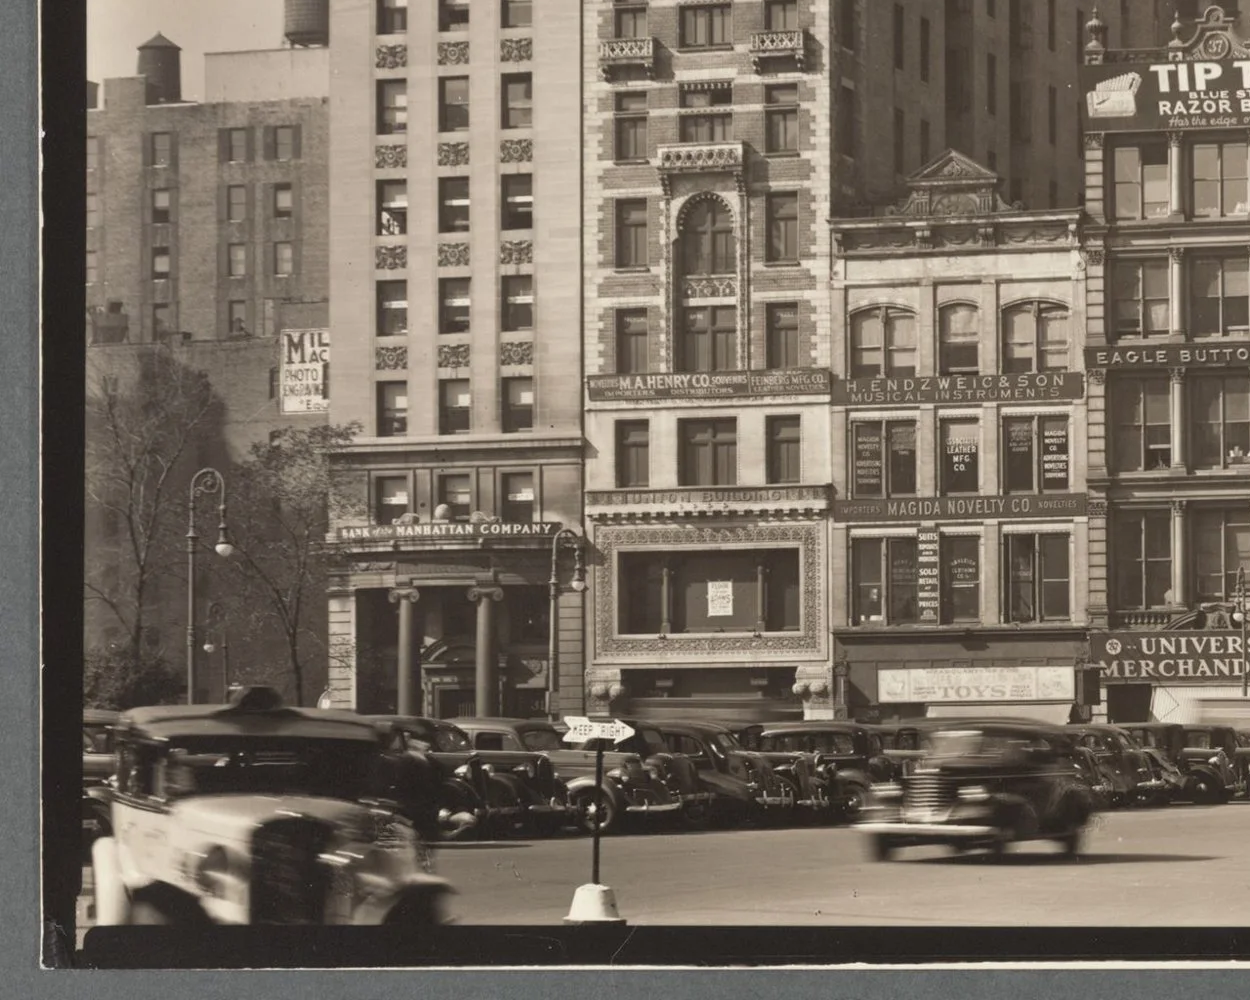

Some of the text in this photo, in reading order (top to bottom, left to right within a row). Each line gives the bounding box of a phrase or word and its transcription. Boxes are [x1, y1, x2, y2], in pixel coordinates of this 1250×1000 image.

[1208, 39, 1223, 54] 37
[1150, 61, 1222, 93] TIP
[1188, 89, 1230, 100] BLUE
[1158, 100, 1233, 116] RAZOR
[1169, 116, 1190, 128] Has
[1191, 116, 1207, 127] the
[1209, 115, 1238, 128] edge
[1096, 350, 1168, 365] EAGLE
[284, 367, 318, 382] PHOTO
[647, 375, 690, 389] HENRY
[999, 376, 1010, 388] &
[1017, 374, 1065, 388] SON
[850, 386, 1060, 402] MUSICAL INSTRUMENTS
[947, 446, 977, 454] LEATHER
[887, 501, 941, 516] MAGIDA
[947, 499, 1005, 515] NOVELTY
[342, 527, 370, 539] BANK
[396, 523, 474, 536] MANHATTAN
[480, 523, 551, 535] COMPANY
[919, 567, 938, 575] SOLD
[937, 684, 1007, 699] TOYS
[573, 724, 626, 737] KEEP RIGHT
